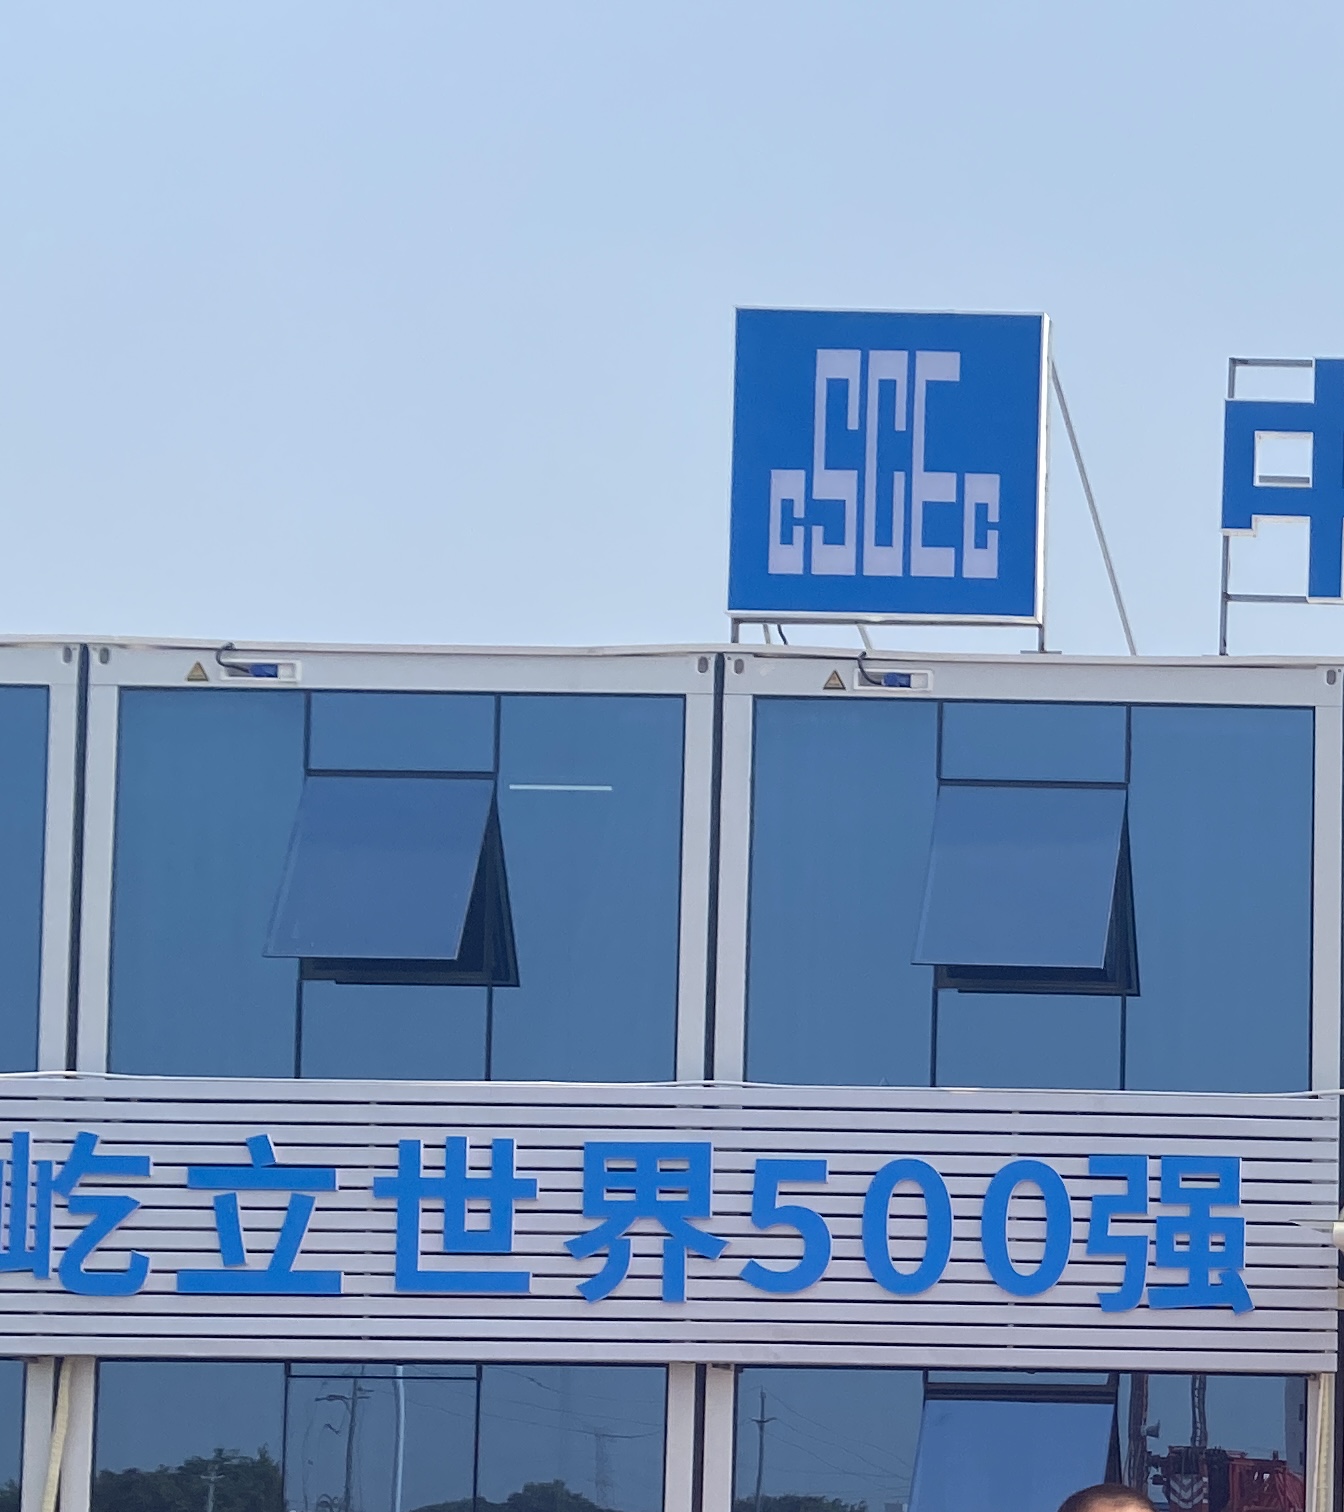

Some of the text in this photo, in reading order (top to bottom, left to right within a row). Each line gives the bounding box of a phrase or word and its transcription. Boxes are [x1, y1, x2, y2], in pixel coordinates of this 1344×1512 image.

[0, 1131, 1253, 1315] 屹立世界500强
